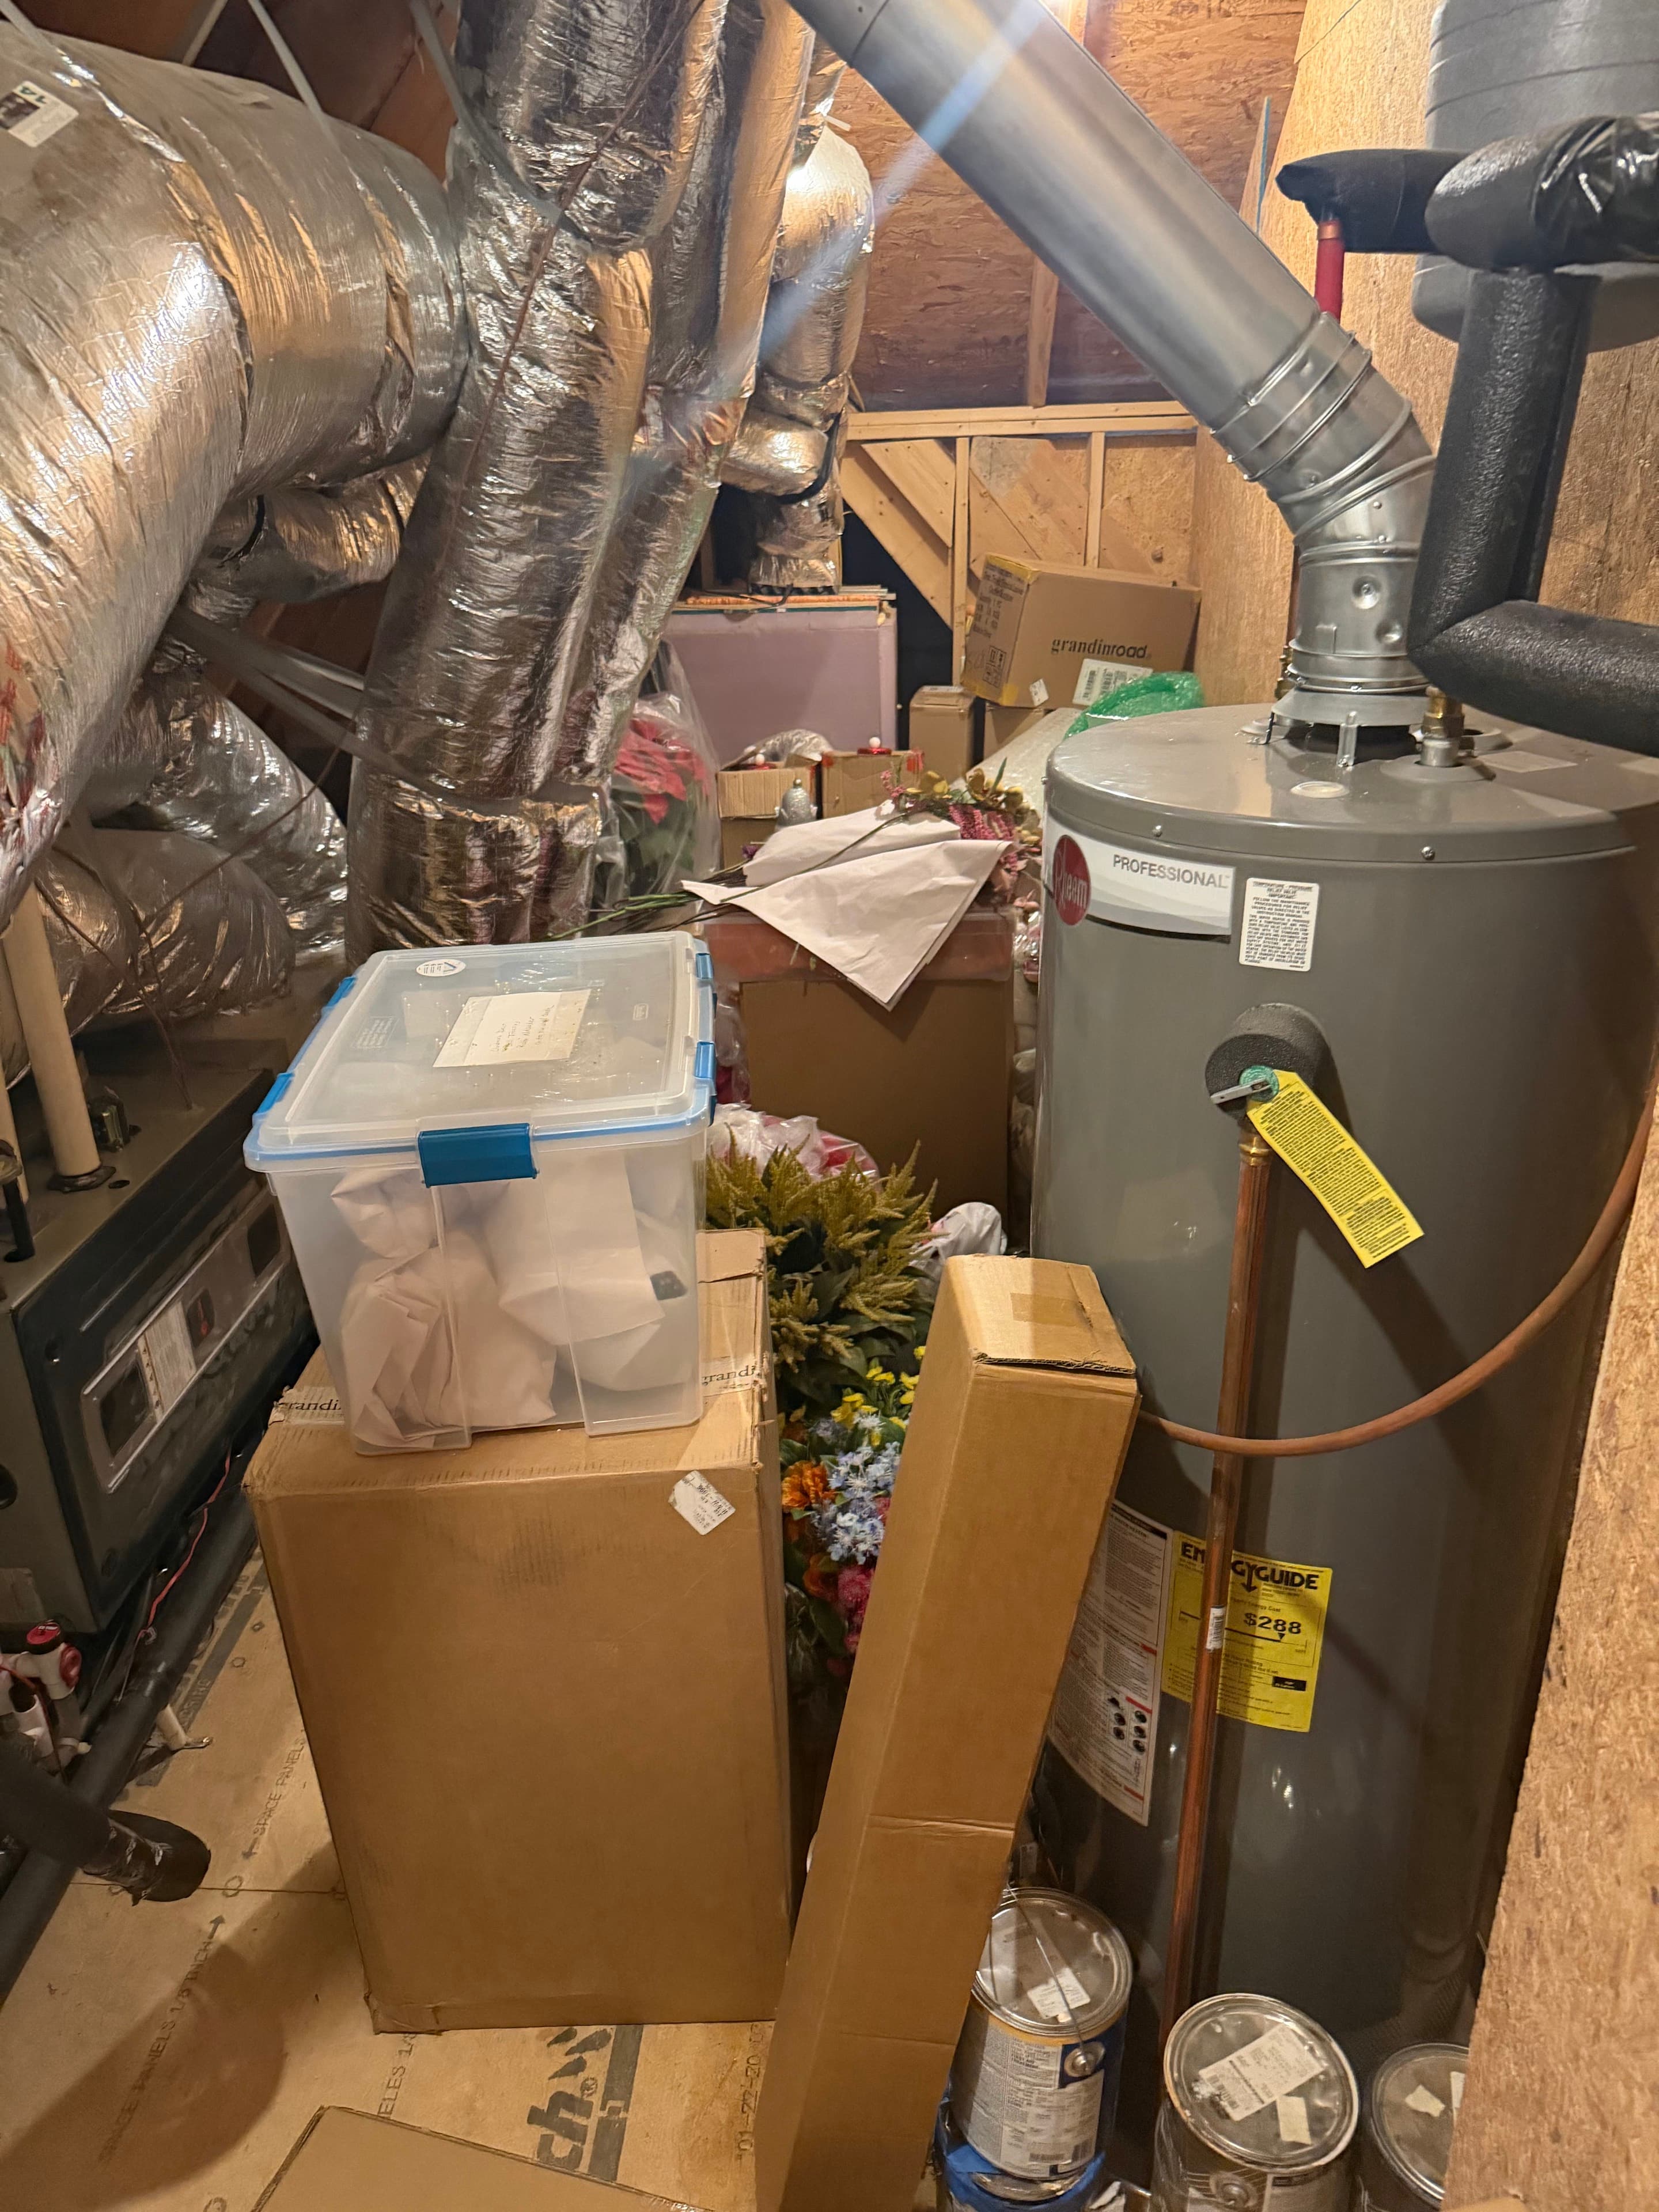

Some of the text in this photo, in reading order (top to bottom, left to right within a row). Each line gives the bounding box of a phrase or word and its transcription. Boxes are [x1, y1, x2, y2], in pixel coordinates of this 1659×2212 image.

[1051, 638, 1147, 659] grandinroad
[1054, 838, 1088, 910] Rheem
[1113, 854, 1229, 889] PROFESSIONAL
[279, 1398, 342, 1411] randi
[1244, 1612, 1302, 1635] $288
